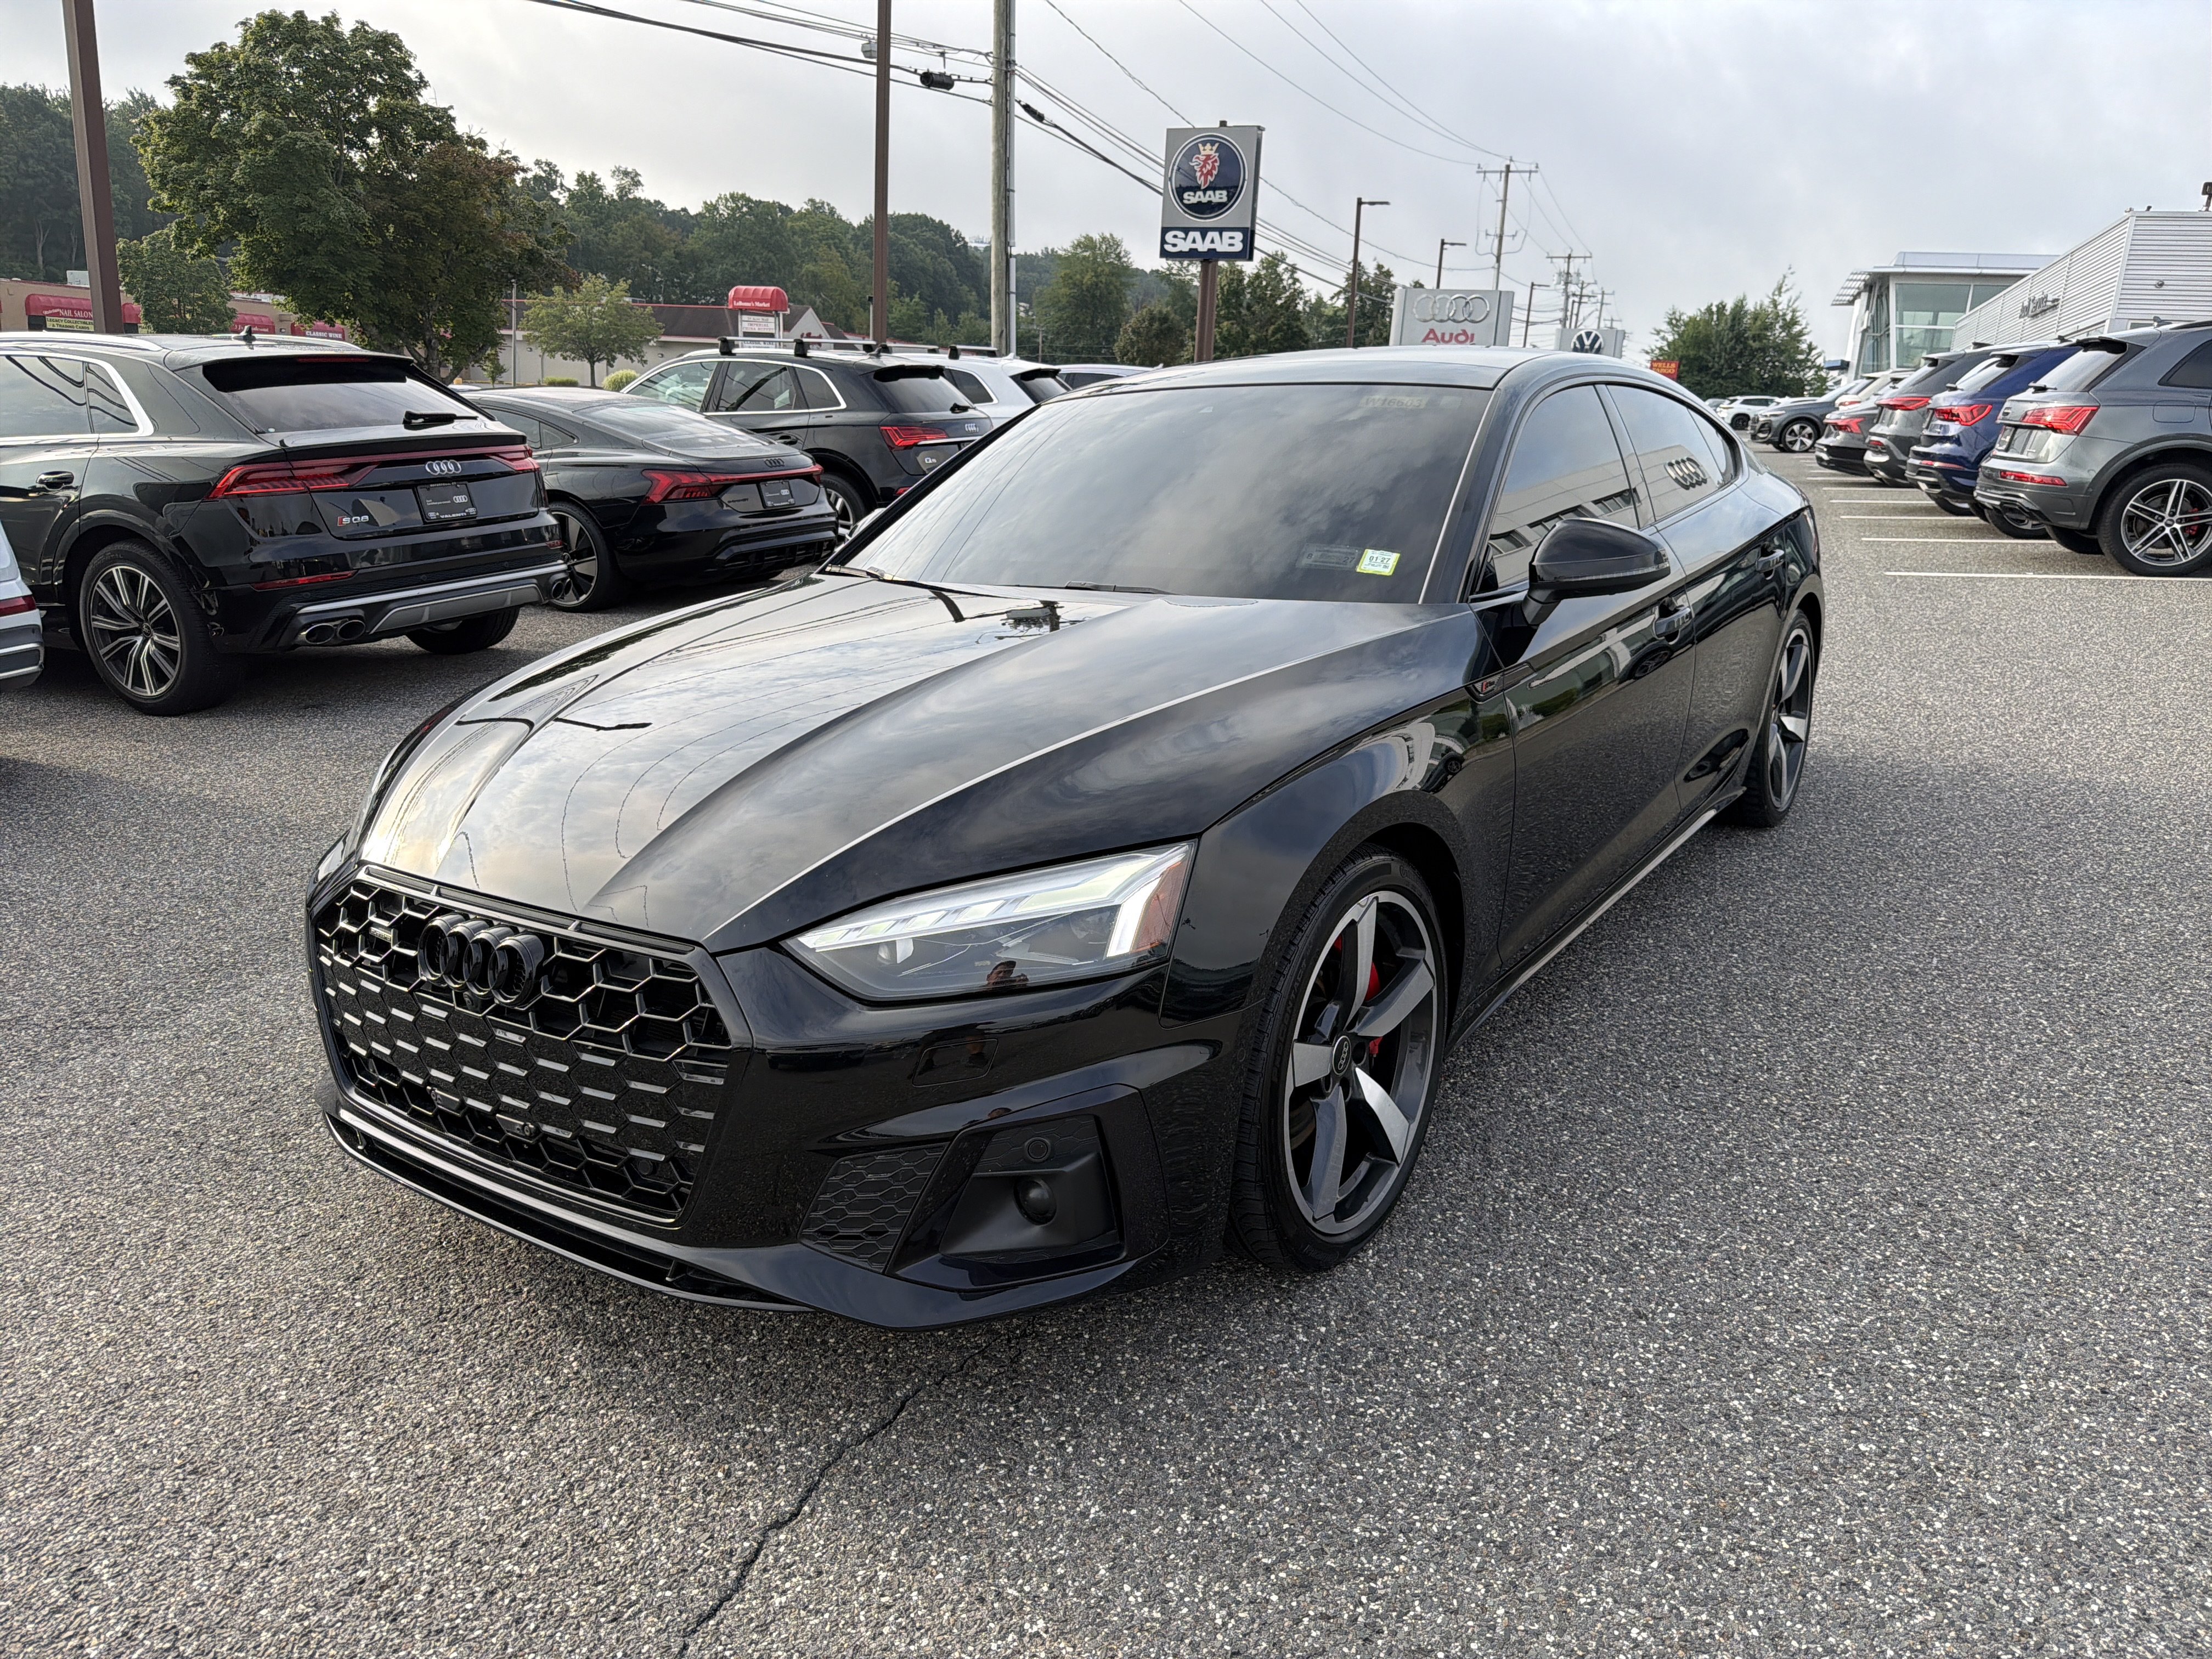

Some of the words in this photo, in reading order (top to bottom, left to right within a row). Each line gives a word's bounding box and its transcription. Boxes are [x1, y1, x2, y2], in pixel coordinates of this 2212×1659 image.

[1183, 190, 1228, 204] SAAB
[1164, 230, 1243, 252] SAAB
[74, 310, 93, 318] SALON
[1421, 328, 1475, 345] Audi
